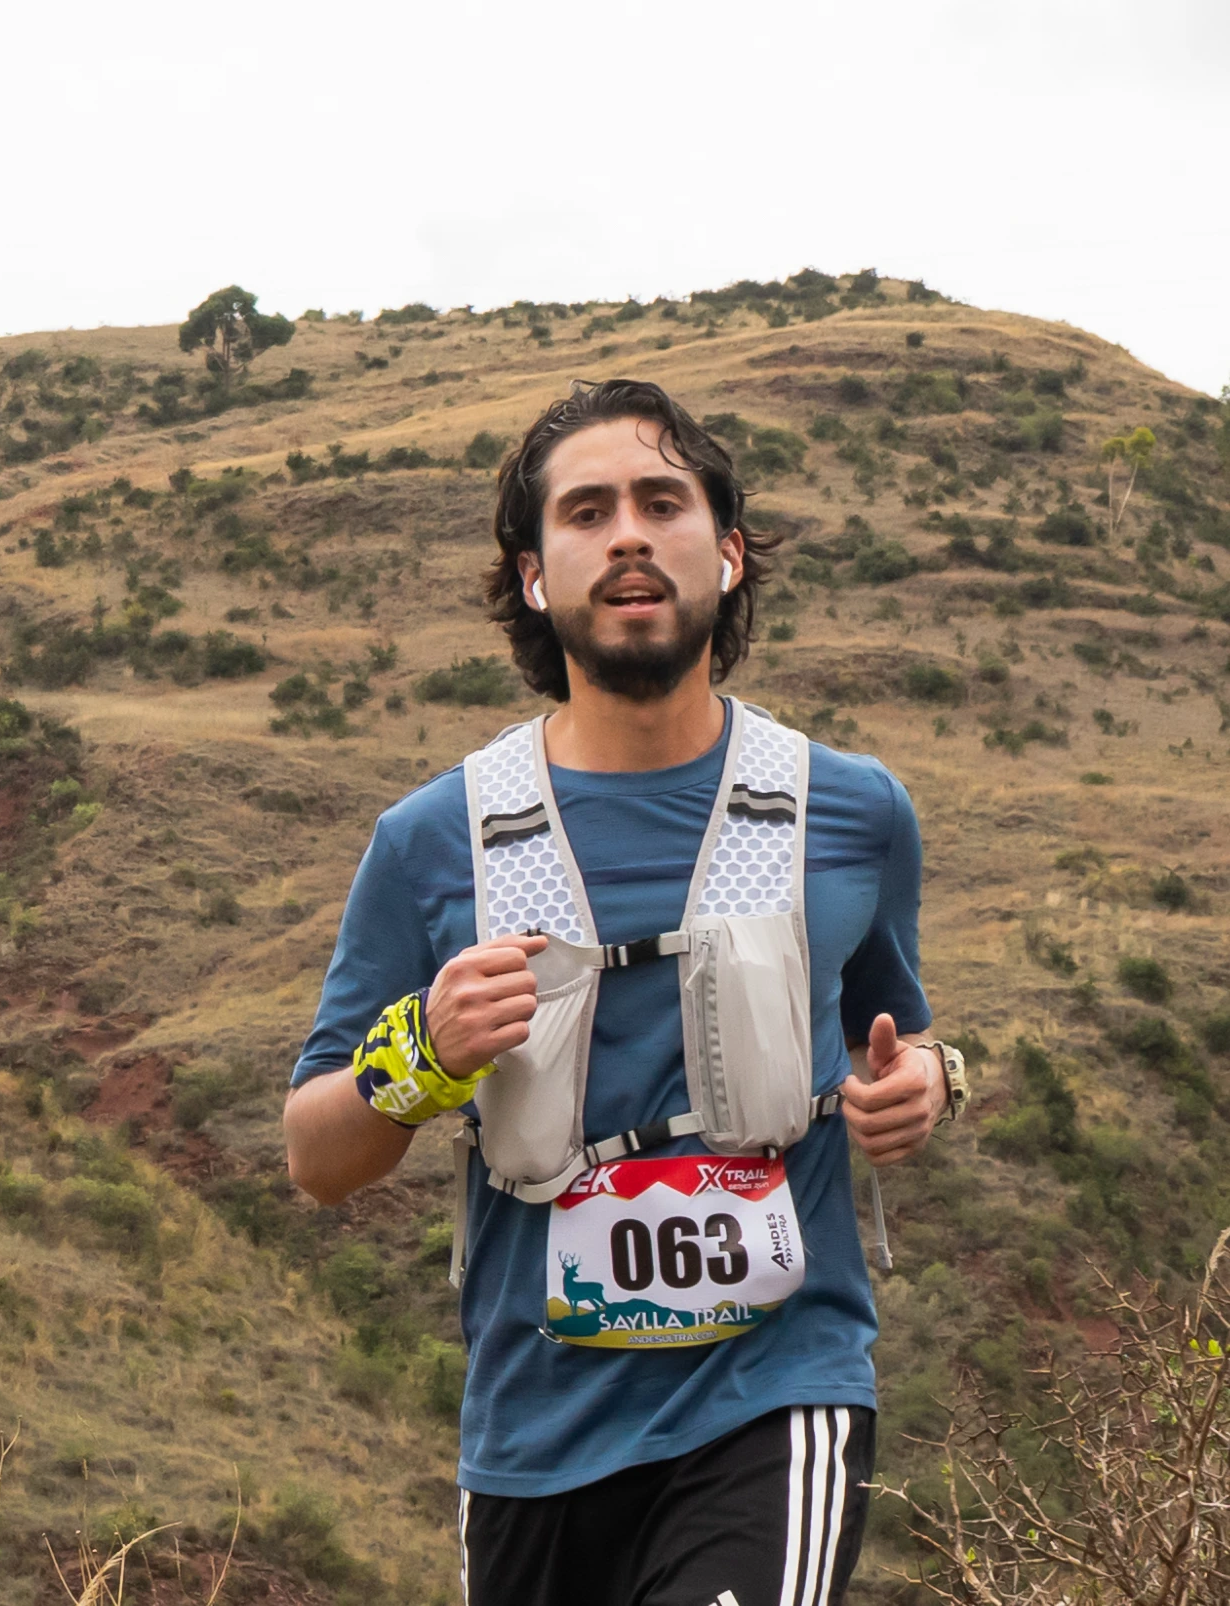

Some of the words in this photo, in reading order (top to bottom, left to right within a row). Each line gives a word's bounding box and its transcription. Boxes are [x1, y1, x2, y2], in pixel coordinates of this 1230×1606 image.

[725, 1169, 768, 1183] TRAIL
[766, 1213, 789, 1271] ANDES
[778, 1214, 790, 1247] ULTRA
[610, 1213, 749, 1291] 063
[599, 1311, 684, 1331] SAYLLA
[692, 1302, 752, 1327] TRAIL
